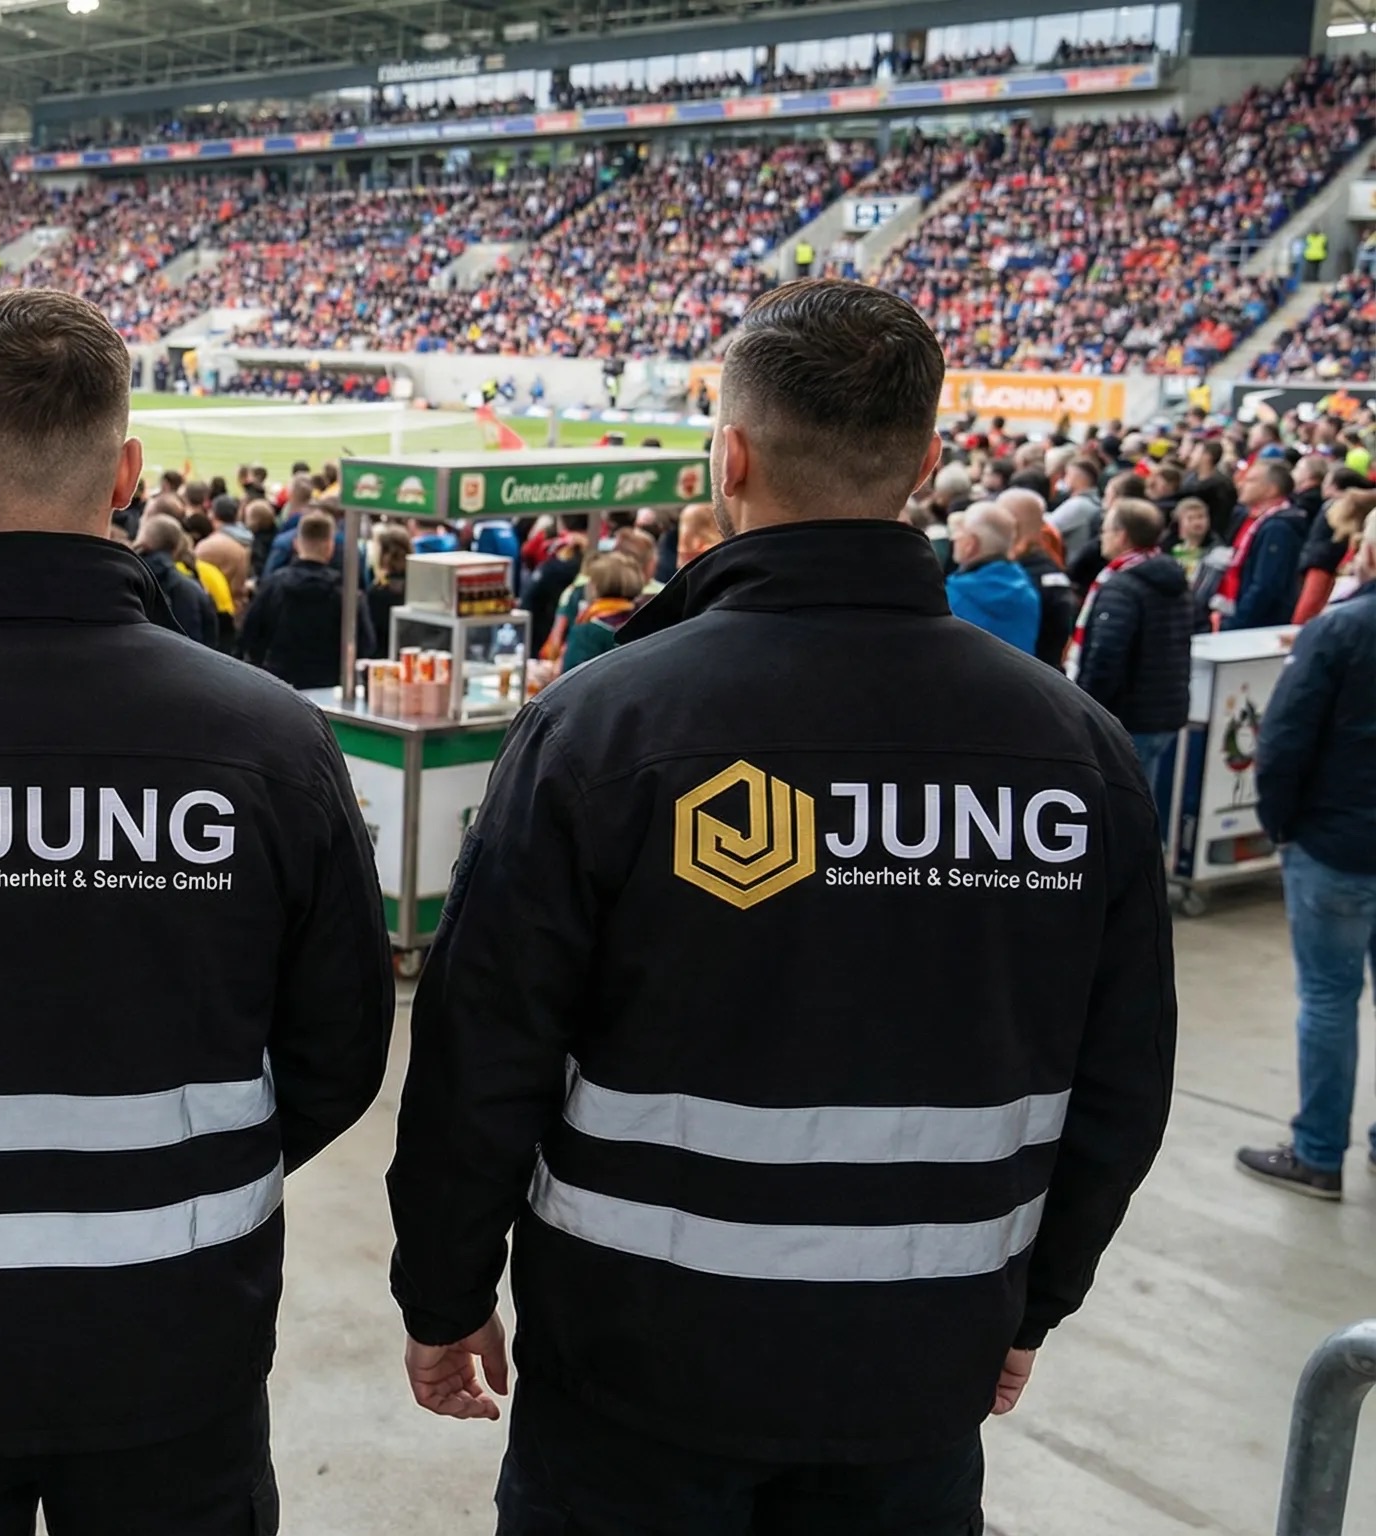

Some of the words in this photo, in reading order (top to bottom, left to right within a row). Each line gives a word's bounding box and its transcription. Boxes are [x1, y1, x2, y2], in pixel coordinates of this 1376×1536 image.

[825, 783, 1088, 863] JUNG
[73, 870, 87, 888] &
[94, 870, 167, 890] Service
[173, 872, 232, 890] GmbH
[825, 867, 921, 886] Sicherheit
[927, 868, 941, 886] &
[948, 868, 1020, 888] Service
[1026, 871, 1083, 890] GmbH
